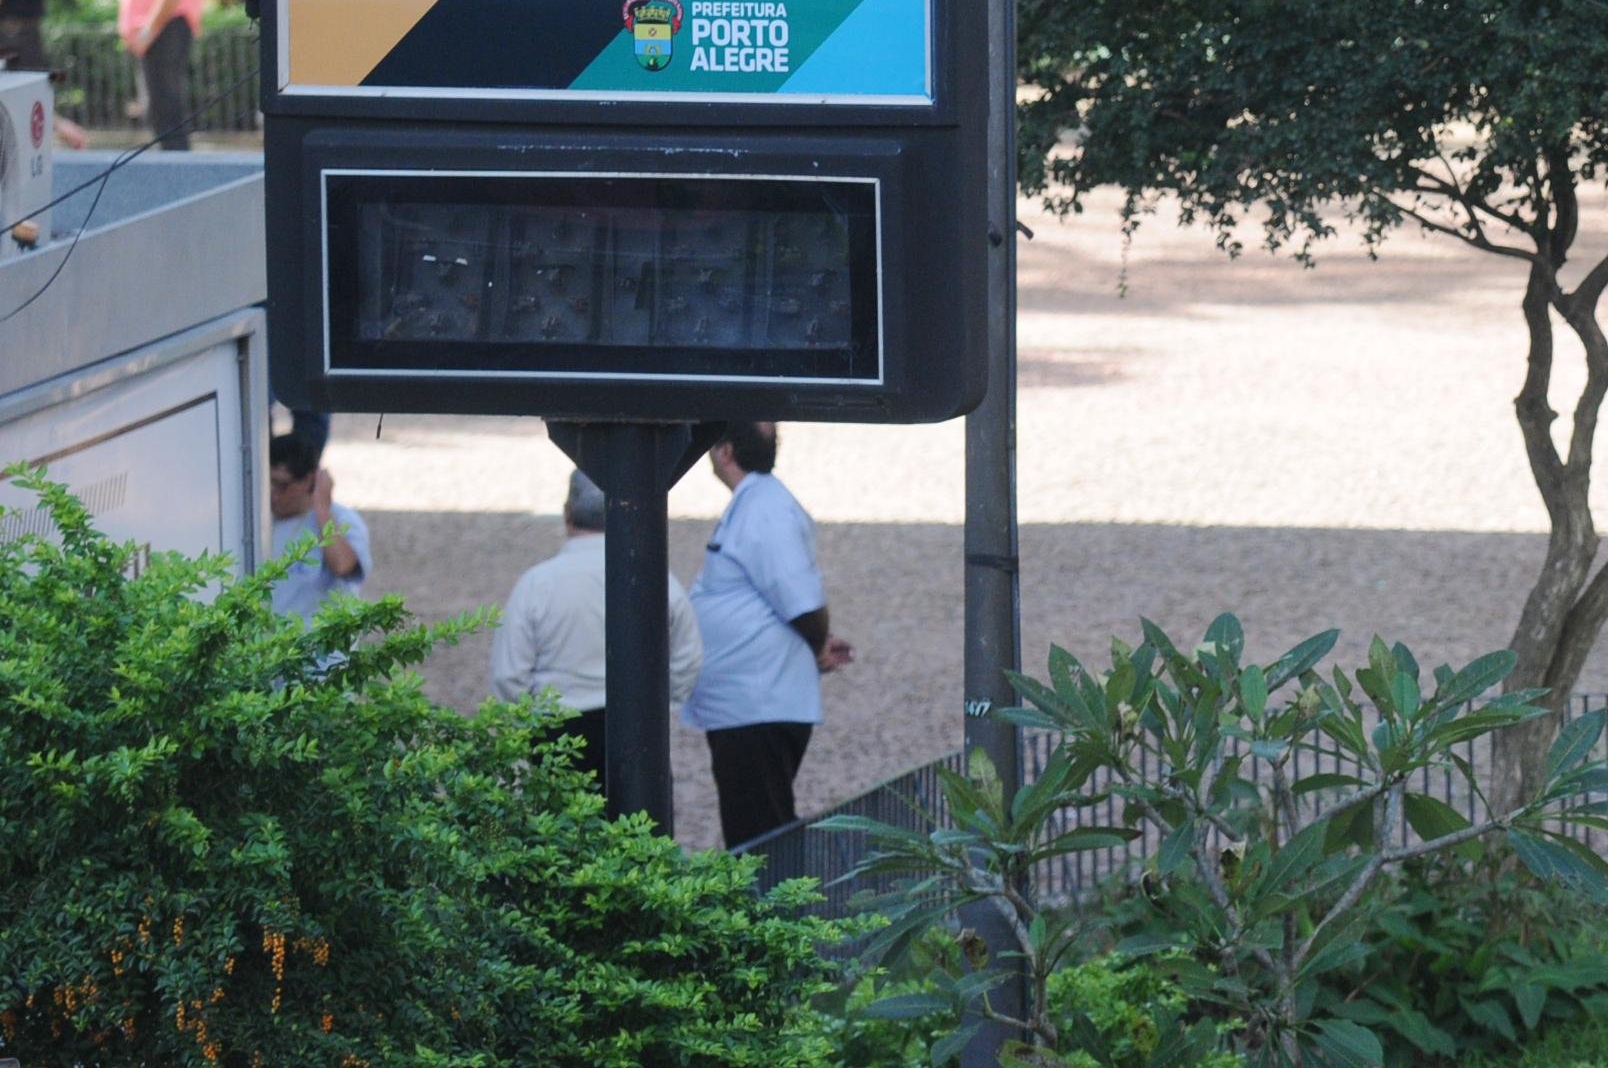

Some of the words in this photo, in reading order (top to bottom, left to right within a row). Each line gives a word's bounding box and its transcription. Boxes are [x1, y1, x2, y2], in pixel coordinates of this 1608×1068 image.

[692, 1, 787, 18] PREFEITURA
[691, 18, 789, 47] PORTO
[690, 47, 789, 73] ALEGRE
